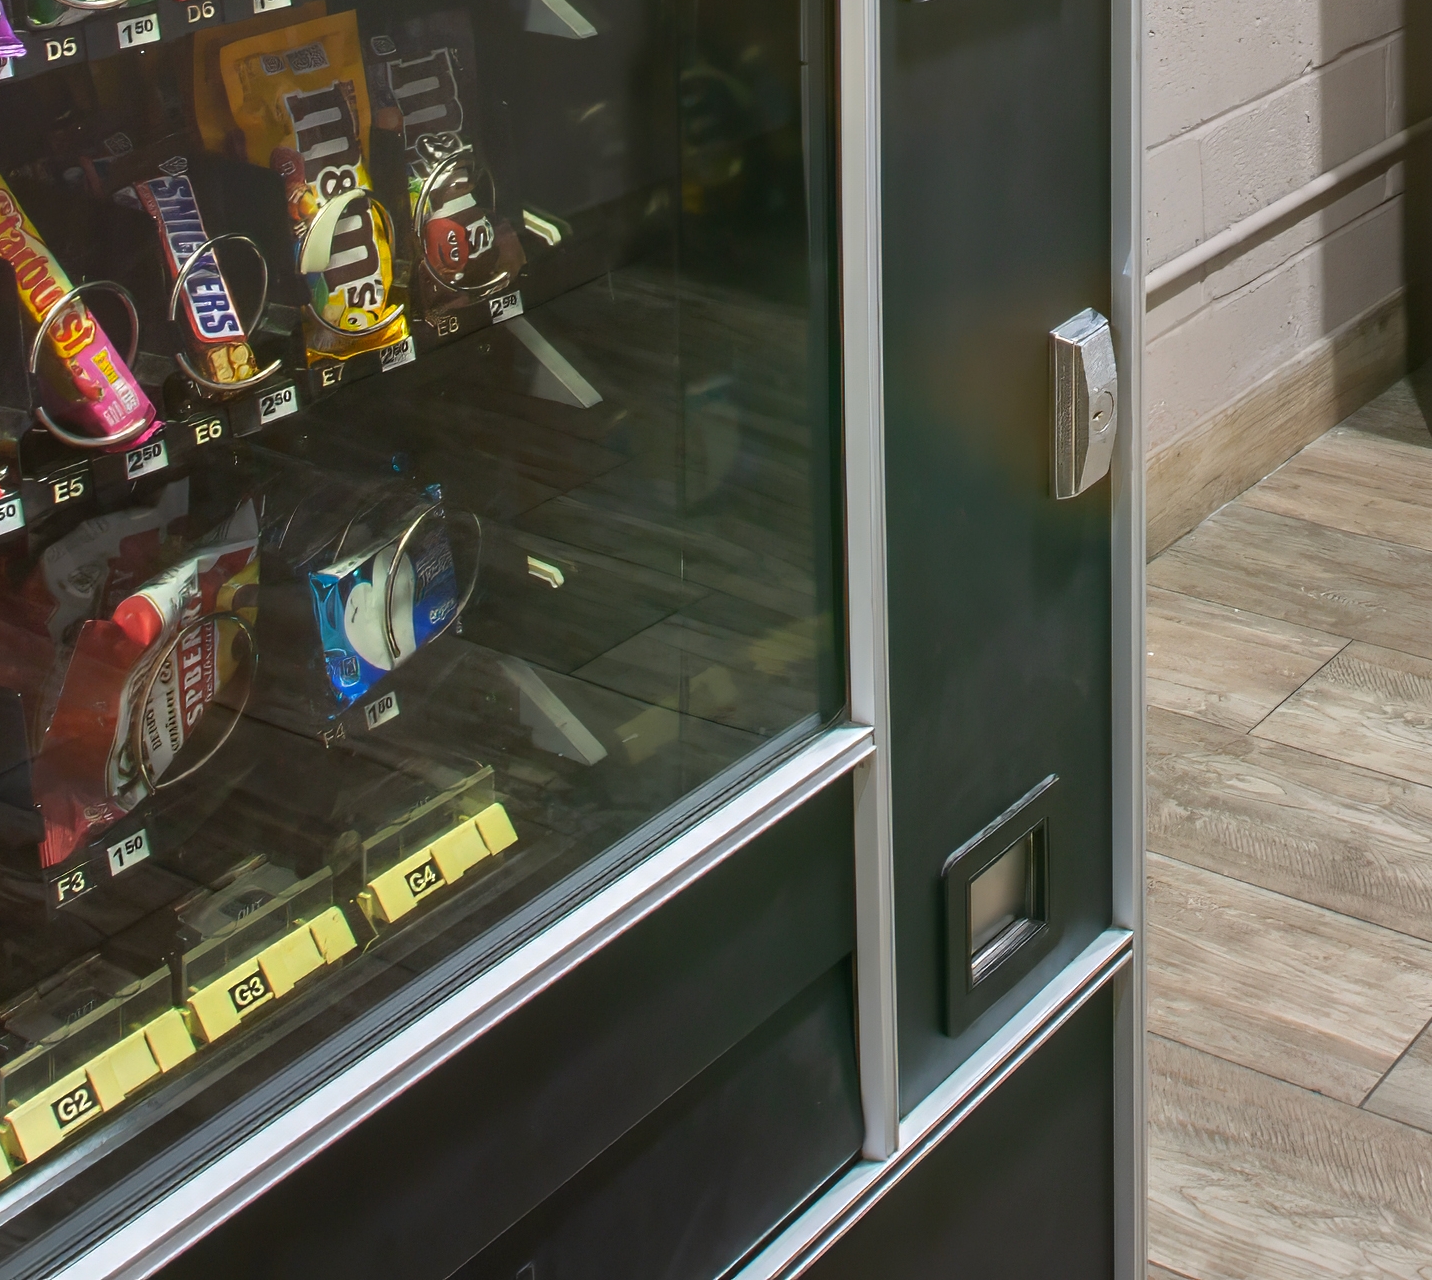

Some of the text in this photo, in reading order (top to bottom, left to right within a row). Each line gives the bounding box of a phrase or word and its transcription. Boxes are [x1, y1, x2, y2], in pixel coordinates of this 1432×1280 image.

[186, 0, 216, 23] D6
[46, 19, 155, 62] D5 150
[149, 178, 242, 336] SNICKERS
[322, 366, 346, 388] E7
[194, 389, 293, 444] E6 250
[53, 444, 163, 502] E5 250
[323, 722, 347, 748] F4
[56, 835, 145, 901] F3 150
[409, 864, 438, 893] G4
[233, 976, 266, 1006] G3
[56, 1089, 94, 1122] G2
